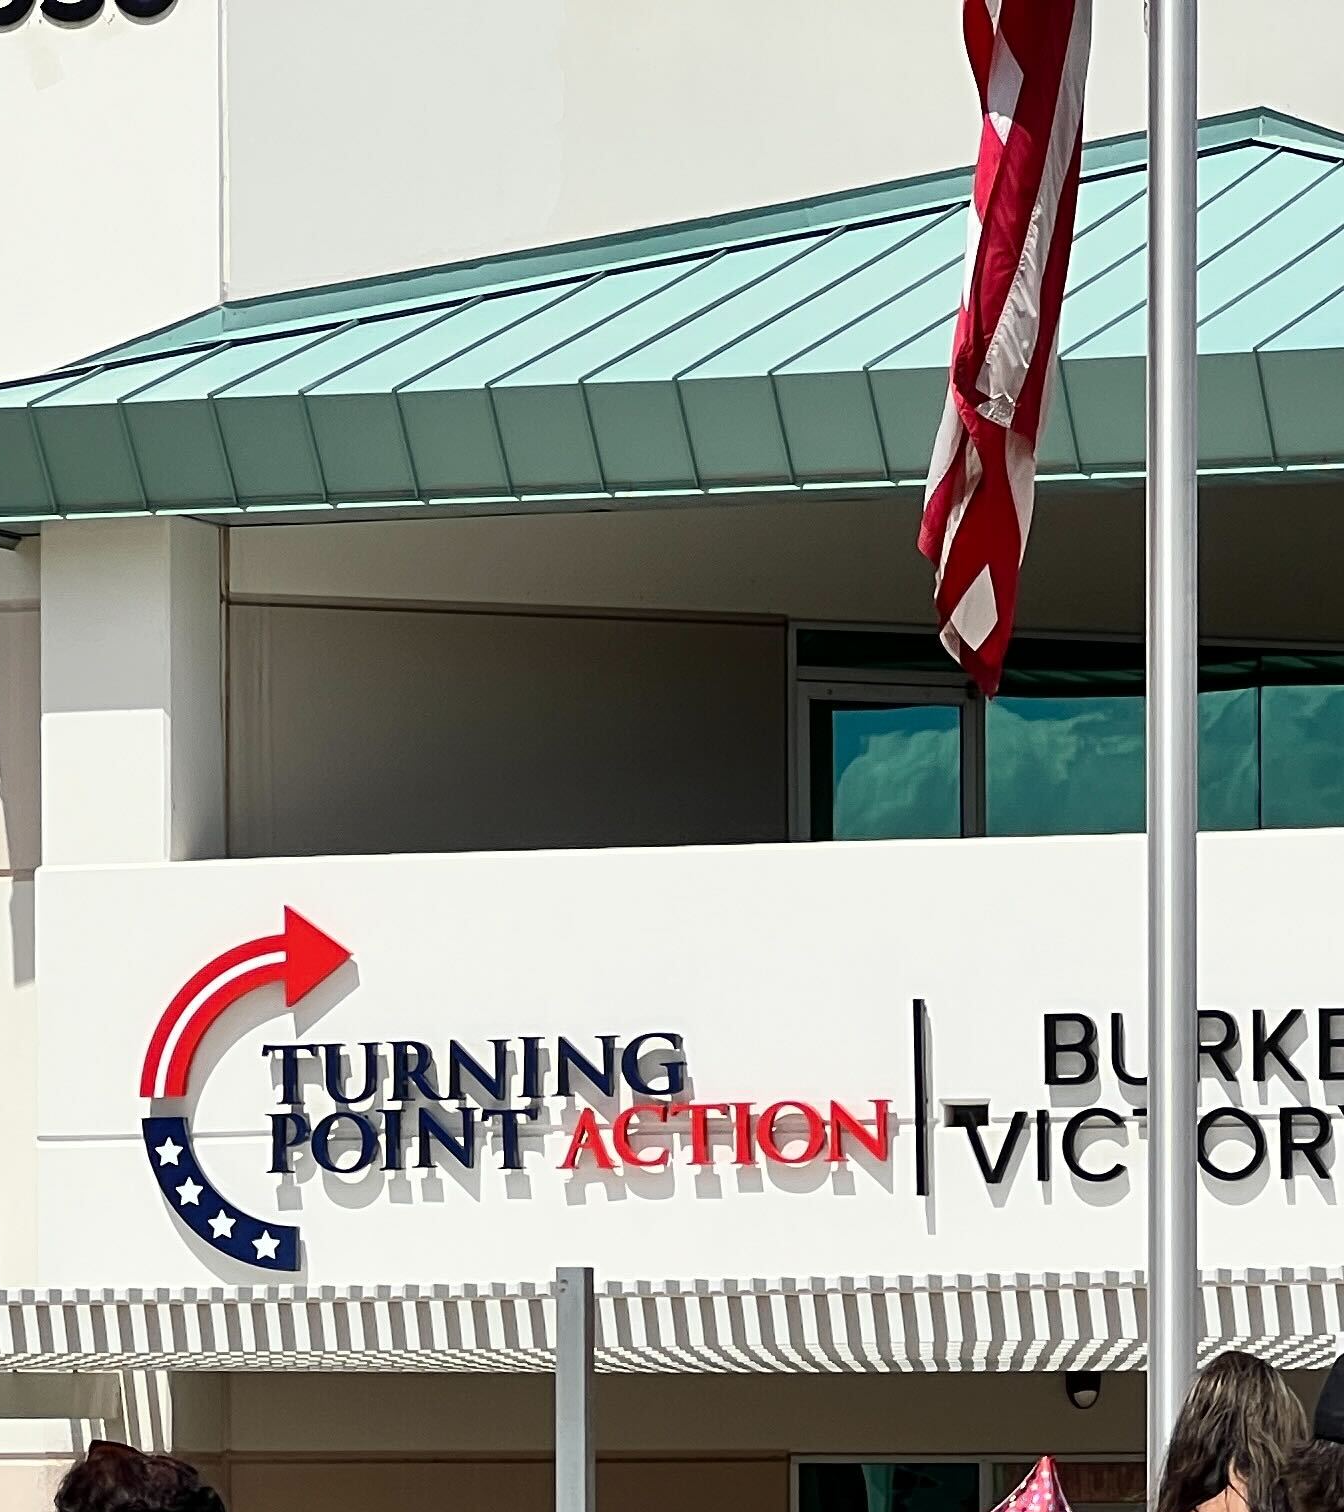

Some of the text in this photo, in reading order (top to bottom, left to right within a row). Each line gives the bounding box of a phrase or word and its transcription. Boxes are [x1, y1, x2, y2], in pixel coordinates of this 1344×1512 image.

[261, 1032, 685, 1106] TURNING
[266, 1098, 892, 1174] POINT ACTION
